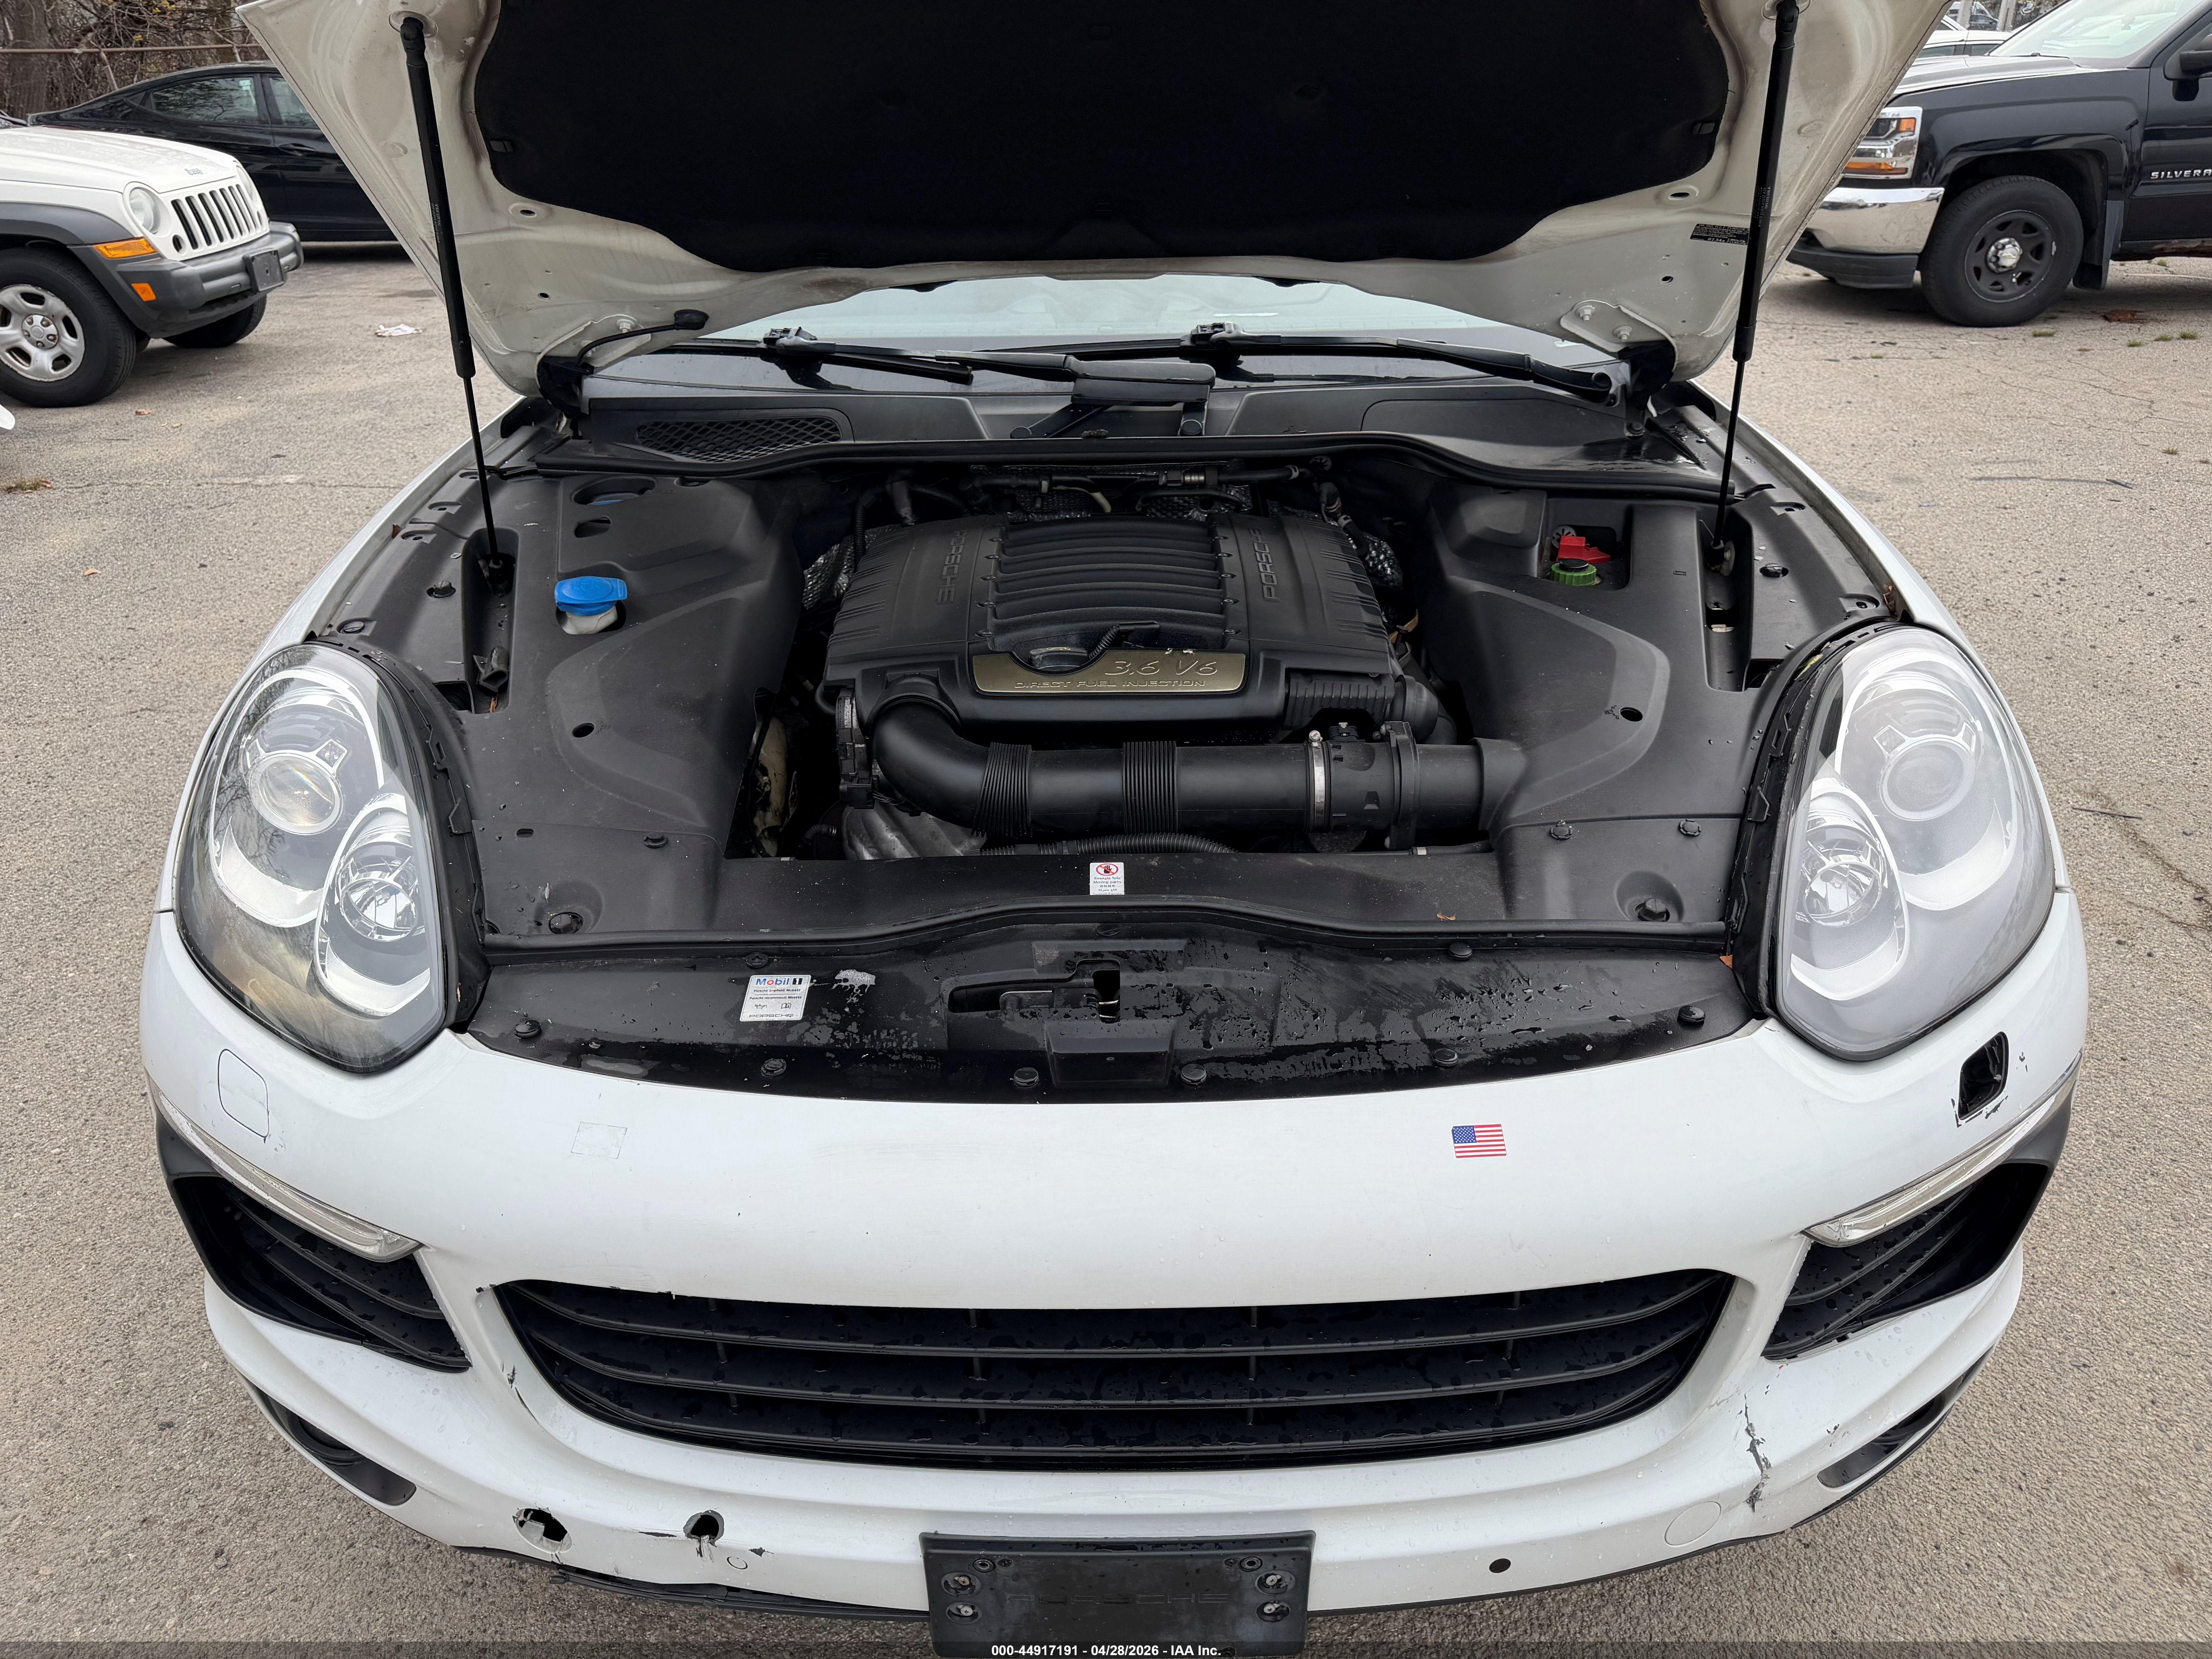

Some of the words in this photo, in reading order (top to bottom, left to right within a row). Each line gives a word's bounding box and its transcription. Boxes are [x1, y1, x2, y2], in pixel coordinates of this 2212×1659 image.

[2150, 169, 2212, 179] SILVERA
[938, 531, 967, 604] PORSCHE
[1248, 528, 1279, 600] PORSCHE
[1104, 661, 1160, 676] 3.6
[1175, 660, 1218, 676] V6
[1006, 1593, 1229, 1604] PORSCHE
